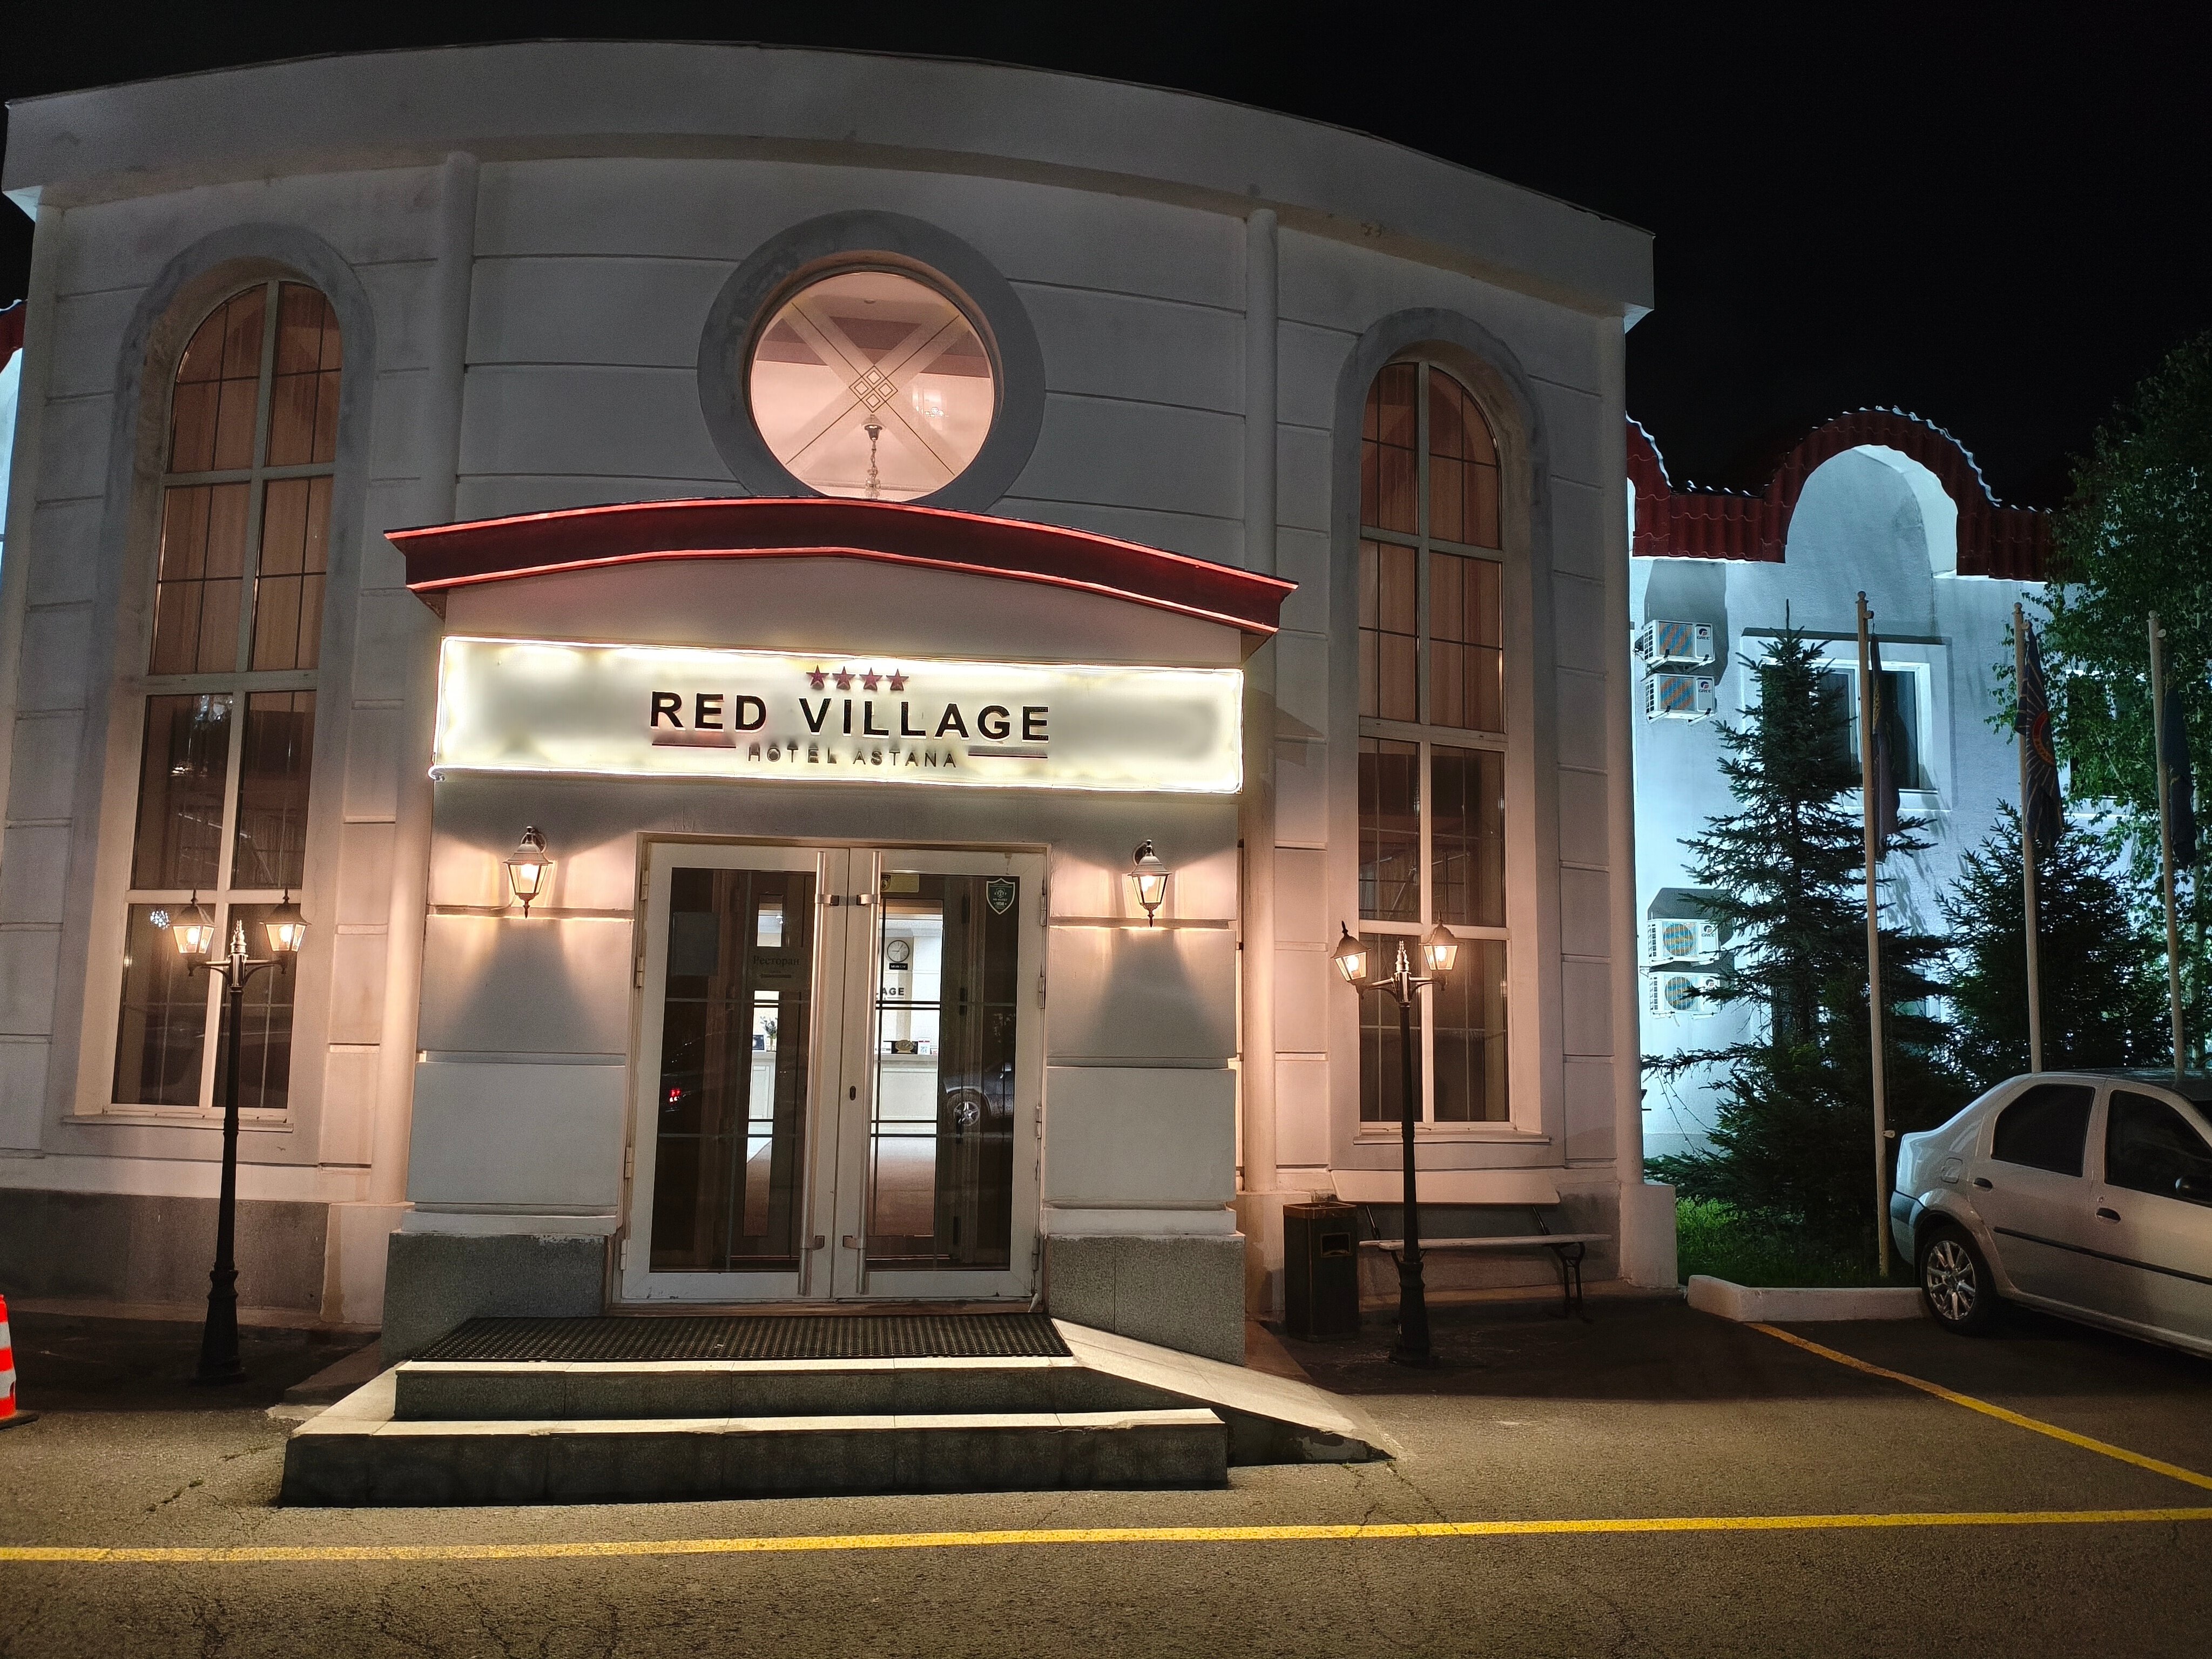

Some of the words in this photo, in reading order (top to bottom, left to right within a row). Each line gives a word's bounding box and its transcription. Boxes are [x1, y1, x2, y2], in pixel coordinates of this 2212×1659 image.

[650, 691, 767, 731] RED
[798, 698, 1049, 742] VILLAGE
[748, 746, 837, 764] HOTEL
[853, 750, 956, 768] ASTANA
[753, 955, 800, 967] Ресторан
[876, 987, 905, 995] AGE
